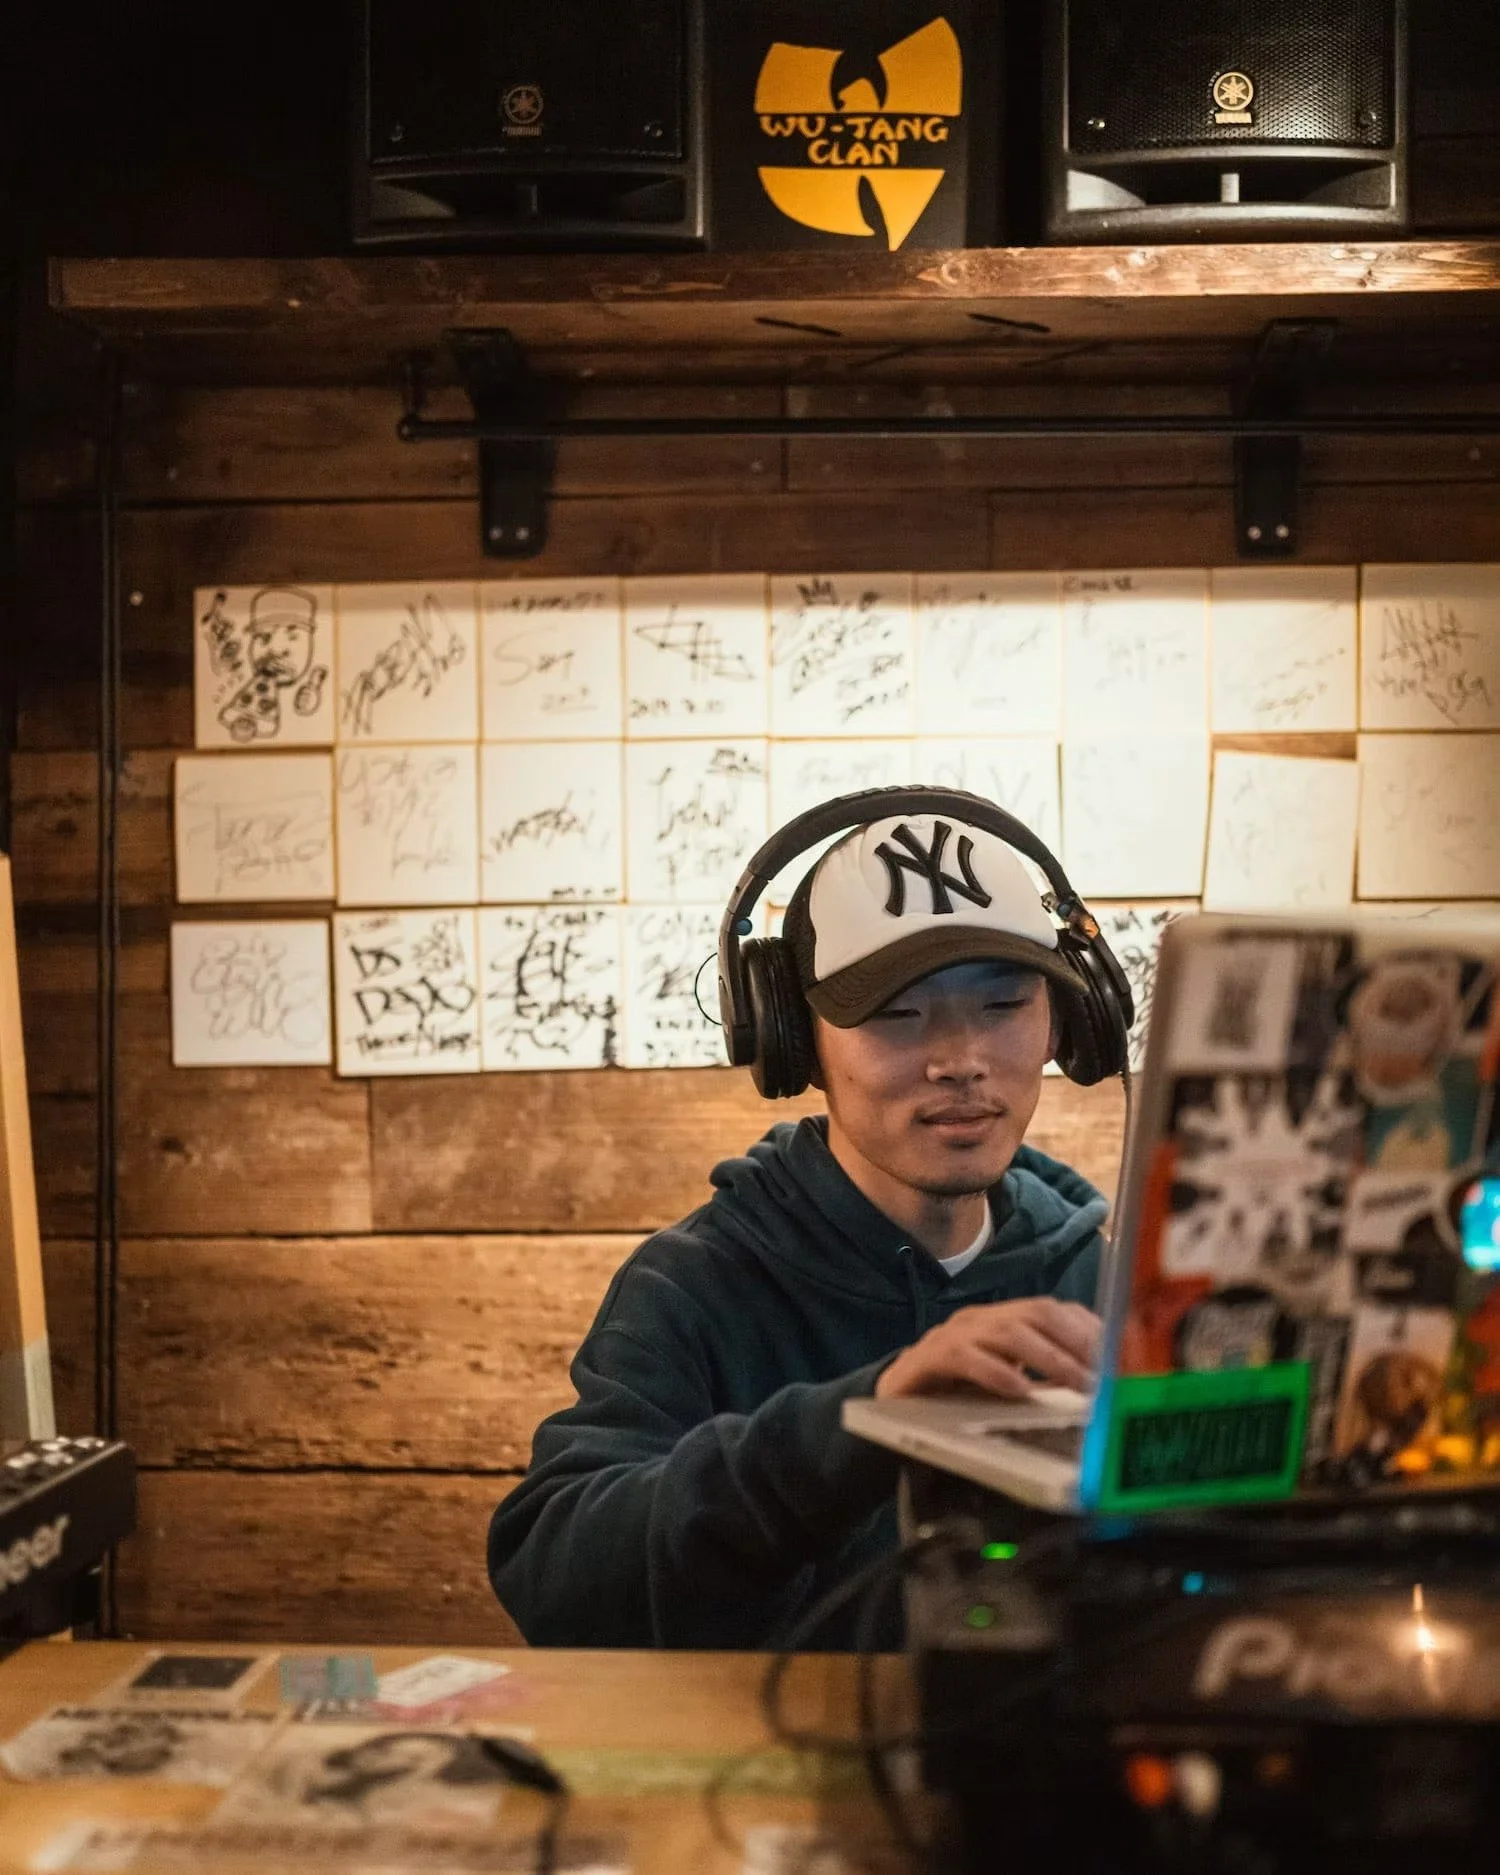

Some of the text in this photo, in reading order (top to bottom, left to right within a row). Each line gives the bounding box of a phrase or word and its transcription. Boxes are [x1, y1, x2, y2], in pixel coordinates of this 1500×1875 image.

[759, 115, 949, 142] WU-TANG
[807, 138, 899, 165] CLAN
[874, 820, 992, 917] NY
